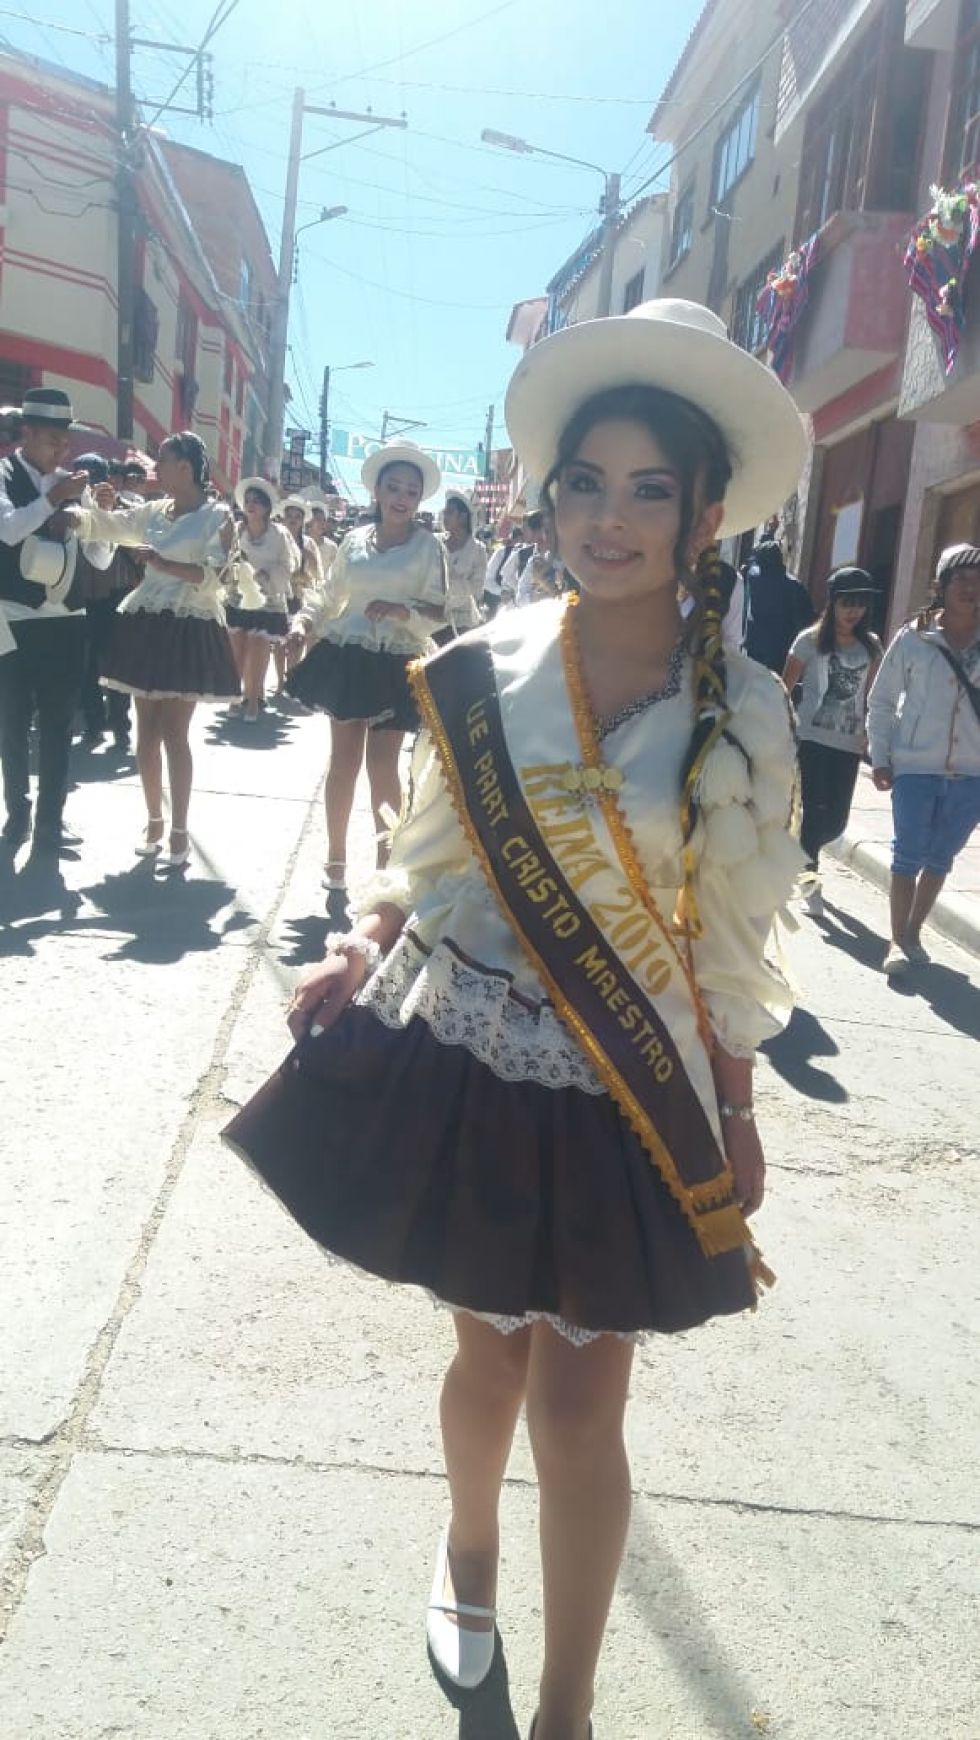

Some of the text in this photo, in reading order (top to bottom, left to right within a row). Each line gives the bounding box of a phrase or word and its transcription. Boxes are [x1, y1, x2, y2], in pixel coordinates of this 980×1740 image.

[500, 836, 581, 938] CRISTO
[574, 944, 674, 1084] MAESTRO
[520, 762, 673, 996] REINA 2019
